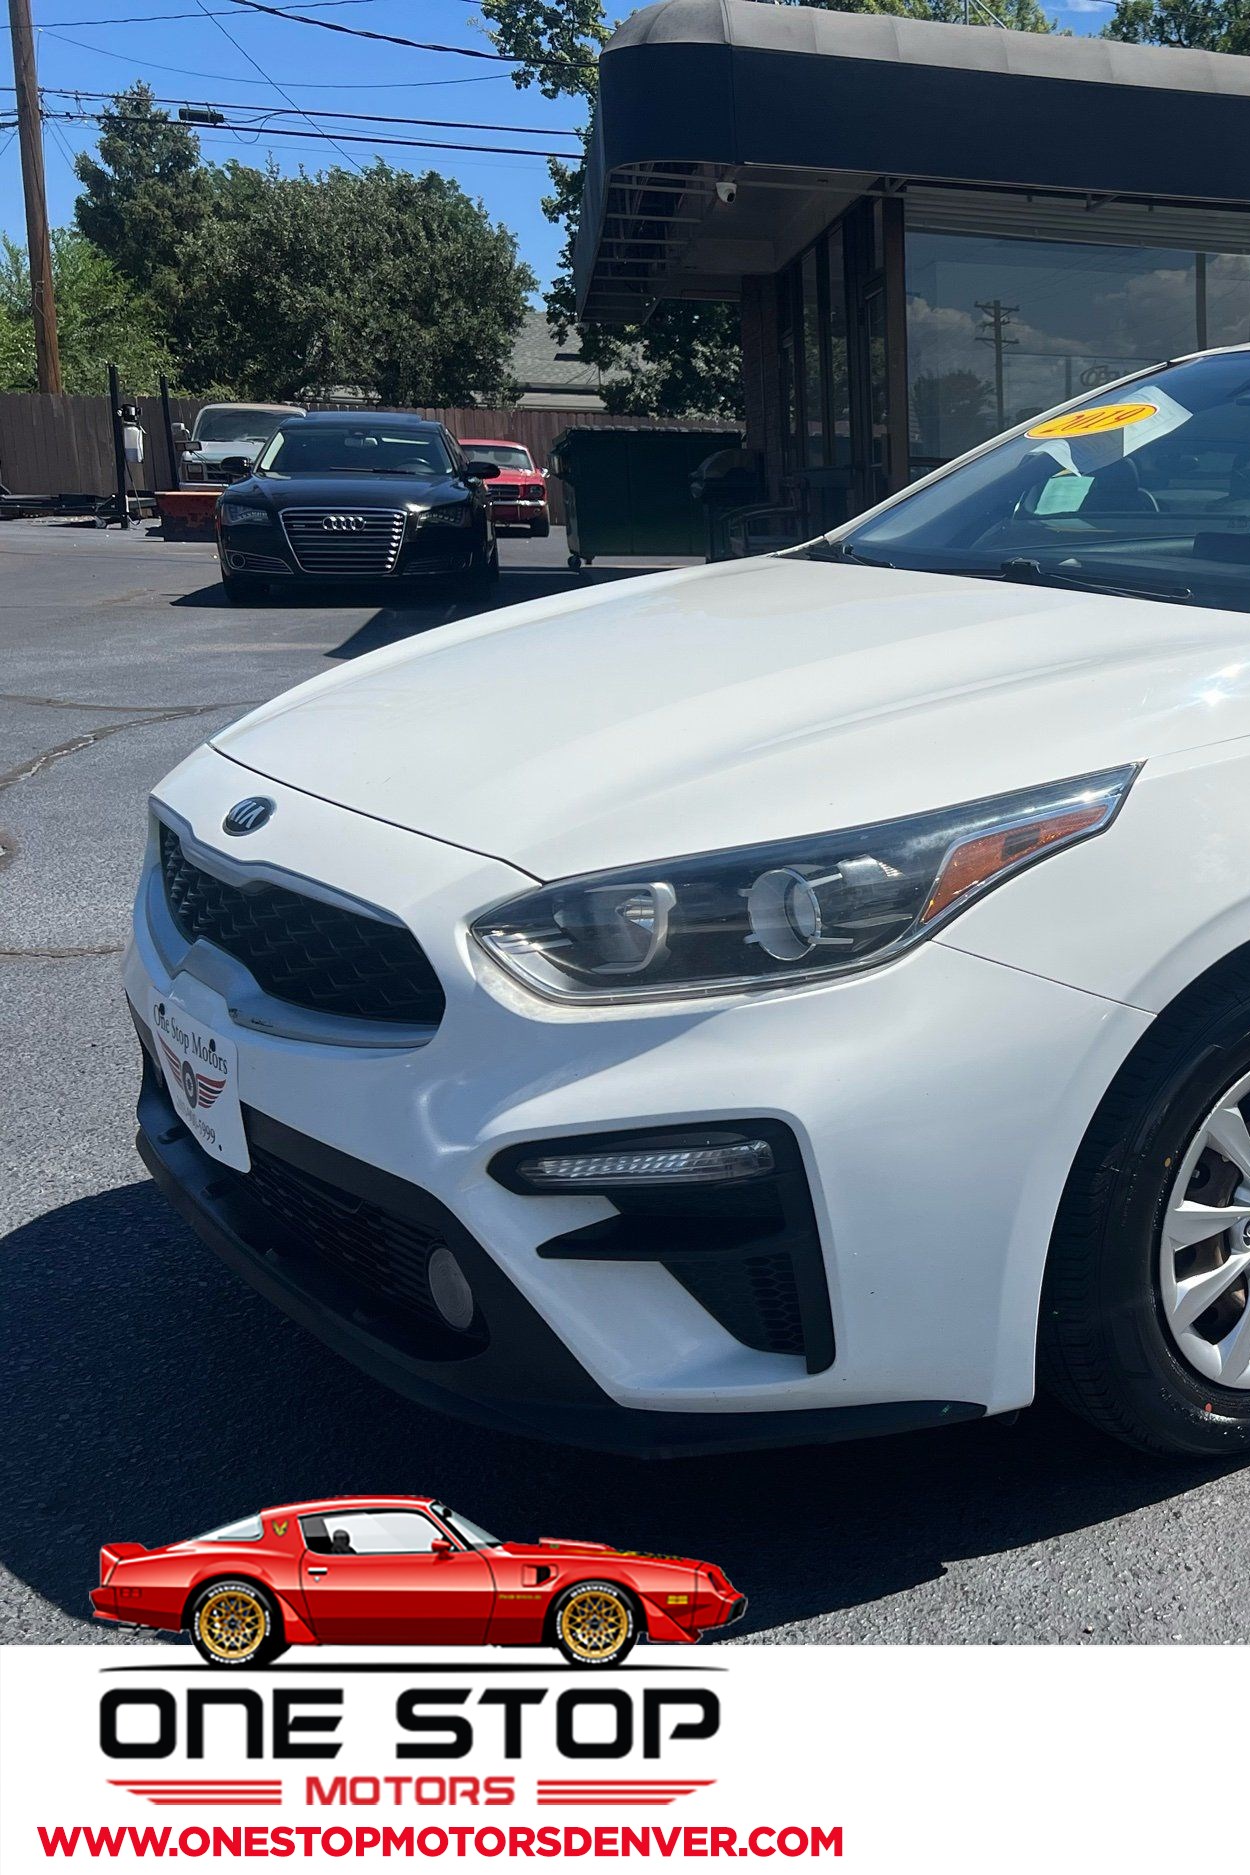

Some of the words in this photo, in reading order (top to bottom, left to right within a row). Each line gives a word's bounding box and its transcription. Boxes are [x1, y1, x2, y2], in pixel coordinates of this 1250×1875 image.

[1038, 407, 1146, 434] 2019
[230, 799, 265, 829] KIA
[153, 1003, 170, 1032] One
[171, 1017, 189, 1054] Stop
[191, 1032, 228, 1075] Motors
